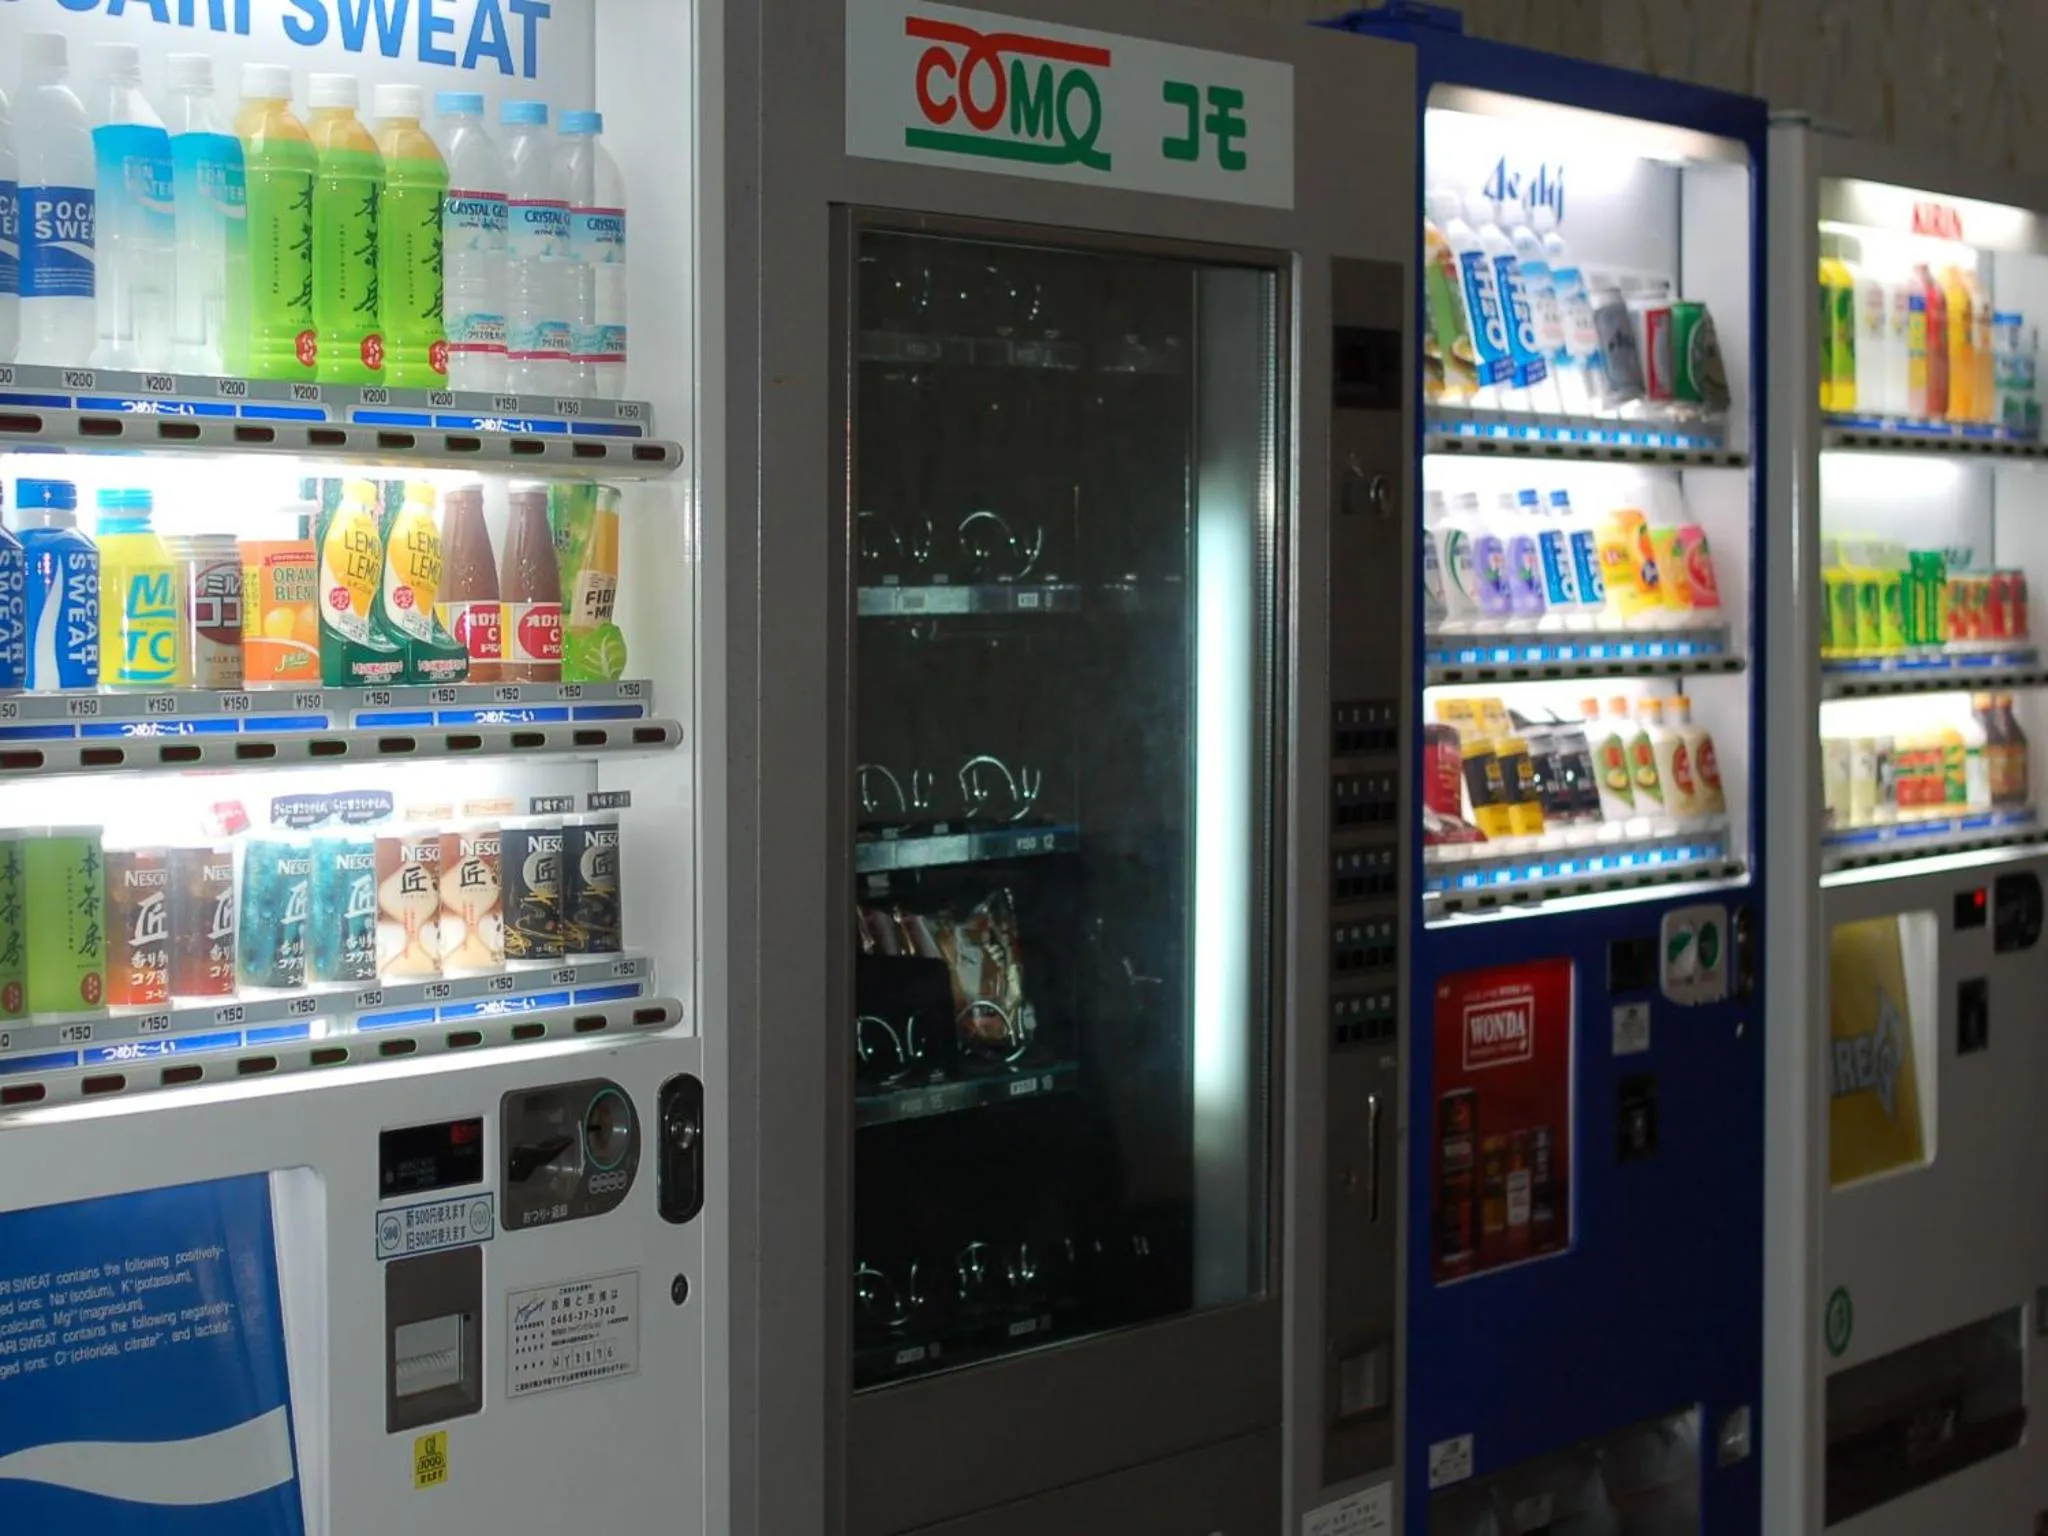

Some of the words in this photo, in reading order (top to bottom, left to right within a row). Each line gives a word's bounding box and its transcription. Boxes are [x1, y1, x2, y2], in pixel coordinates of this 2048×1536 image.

[282, 0, 551, 79] SWEAT
[914, 38, 1102, 148] COMO
[1161, 80, 1247, 171] コモ
[449, 203, 489, 216] CRYSTAL
[525, 211, 562, 223] CRYSTAL
[65, 372, 93, 387] ¥200
[146, 376, 173, 391] ¥200
[220, 380, 245, 395] ¥200
[293, 386, 319, 400] ¥200
[362, 389, 386, 402] ¥200
[430, 392, 452, 405] ¥200
[496, 398, 517, 411] ¥150
[557, 401, 578, 414] ¥150
[618, 404, 638, 417] ¥150
[68, 553, 86, 664] SWEAT
[86, 553, 98, 675] POCARI
[432, 690, 455, 703] ¥150
[497, 687, 519, 700] ¥150
[559, 685, 581, 697] ¥150
[619, 684, 640, 696] ¥150
[223, 697, 249, 710] ¥150
[297, 695, 320, 708] ¥150
[366, 692, 390, 705] ¥150
[70, 700, 97, 715] ¥150
[148, 699, 174, 713] ¥150
[534, 858, 556, 884] 匠
[591, 852, 613, 877] 匠
[401, 865, 428, 894] 匠
[459, 860, 486, 888] 匠
[78, 845, 102, 959] 本茶房
[128, 891, 169, 946] 匠
[613, 962, 635, 975] ¥150
[489, 977, 512, 990] ¥150
[553, 970, 575, 983] ¥150
[425, 984, 450, 997] ¥150
[357, 991, 382, 1005] ¥150
[289, 1000, 316, 1013] ¥150
[216, 1007, 243, 1021] ¥150
[141, 1016, 168, 1031] ¥150
[1470, 1010, 1527, 1044] WONDA
[62, 1025, 91, 1041] ¥150
[12, 1273, 51, 1293] SWEAT
[56, 1266, 100, 1285] contains
[104, 1262, 121, 1277] the
[125, 1254, 169, 1273] following
[20, 1331, 56, 1351] SWEAT
[63, 1324, 107, 1344] contains
[111, 1319, 128, 1333] the
[132, 1311, 177, 1330] following
[172, 1329, 190, 1343] and
